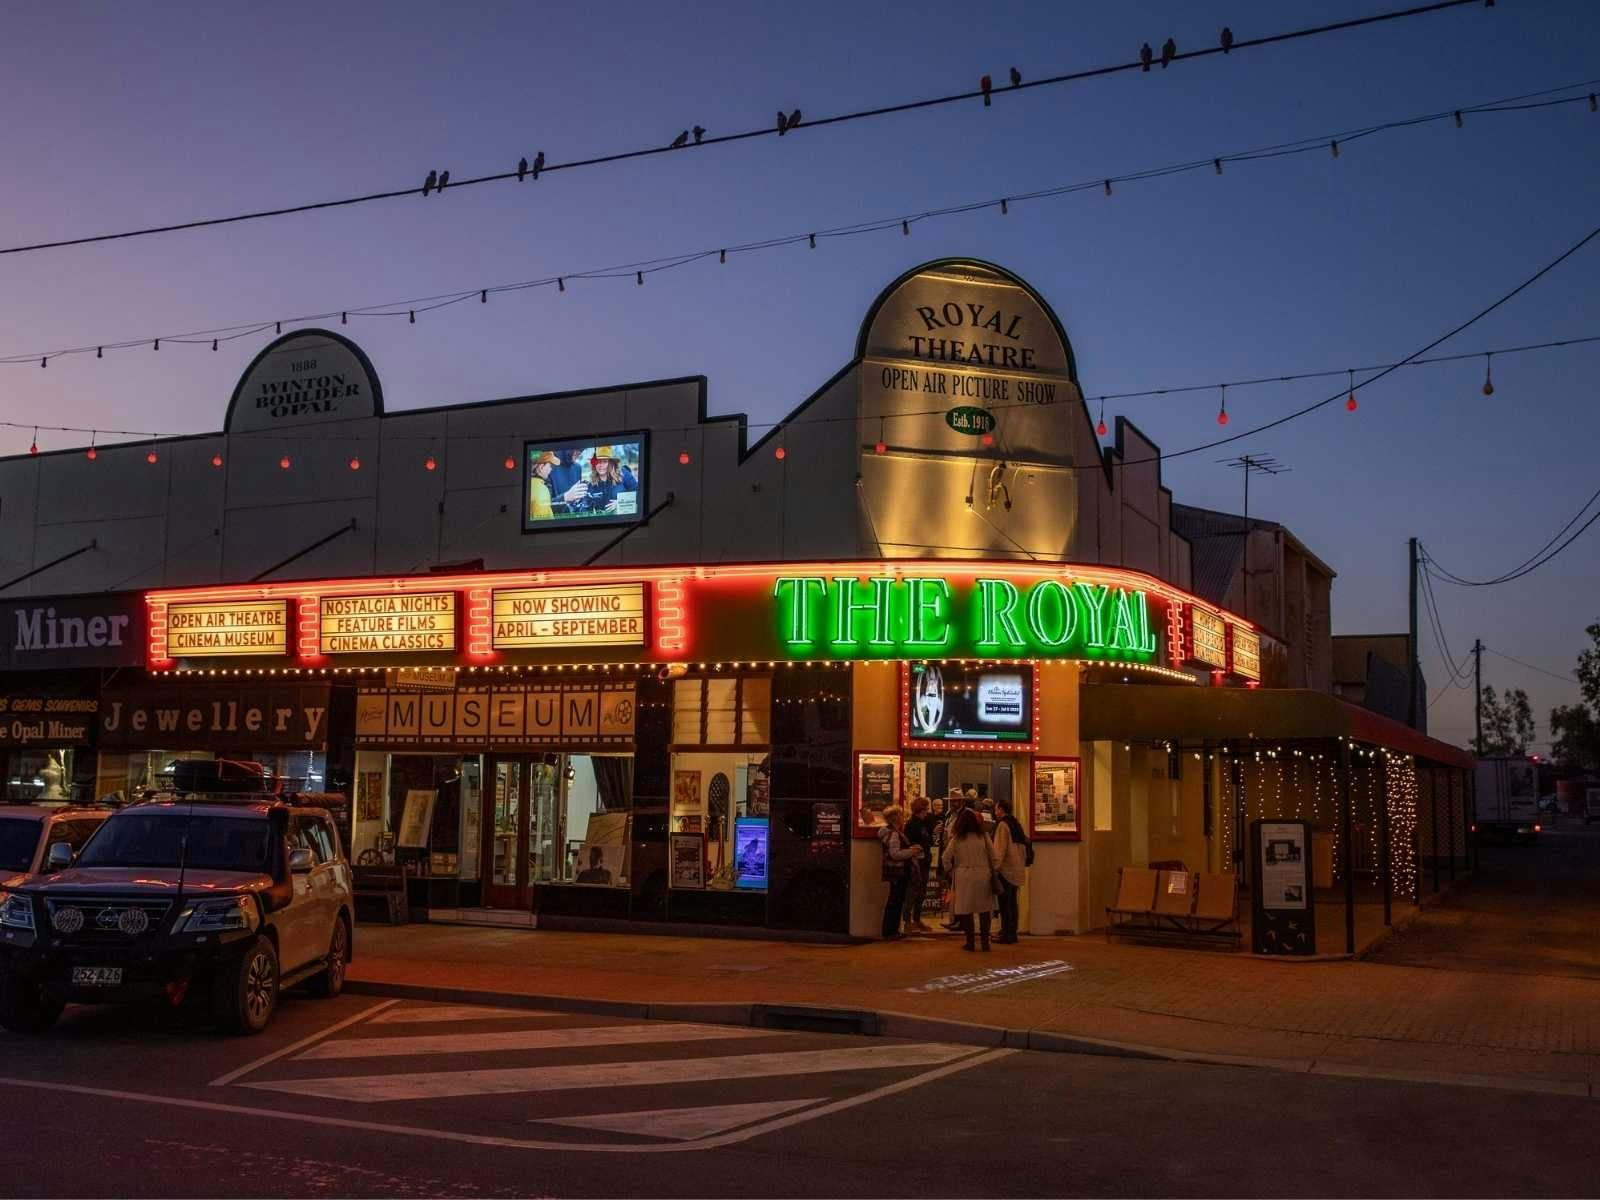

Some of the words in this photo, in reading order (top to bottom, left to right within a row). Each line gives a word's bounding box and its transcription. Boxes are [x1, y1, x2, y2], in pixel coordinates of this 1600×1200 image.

[916, 302, 1024, 340] ROYAL
[908, 335, 1036, 370] THEATRE
[262, 374, 345, 394] WINTON
[881, 367, 919, 391] OPEN
[923, 371, 947, 394] AIR
[952, 375, 1009, 401] PICTURE
[1017, 381, 1056, 405] SHOW
[256, 384, 361, 409] BOULDER
[270, 400, 340, 418] OPAL
[325, 599, 396, 615] NOSTALGIA
[400, 596, 449, 612] NIGHTS
[512, 599, 546, 614] NOW
[551, 596, 621, 613] SHOWING
[774, 576, 951, 647] THE
[975, 578, 1156, 654] ROYAL
[13, 606, 129, 651] Miner
[171, 612, 202, 628] OPEN
[206, 612, 225, 627] AIR
[229, 610, 281, 627] THEATRE
[337, 618, 394, 633] FEATURE
[397, 616, 436, 631] FILMS
[496, 621, 538, 638] APRIL
[552, 618, 638, 636] SEPTEMBER
[177, 632, 221, 648] CINEMA
[226, 630, 275, 646] MUSEUM
[329, 635, 378, 651] CINEMA
[382, 633, 444, 649] CLASSICS
[104, 702, 326, 741] Jewellery
[393, 698, 594, 729] MUSEUM
[12, 720, 45, 743] Opal
[48, 720, 86, 738] Miner
